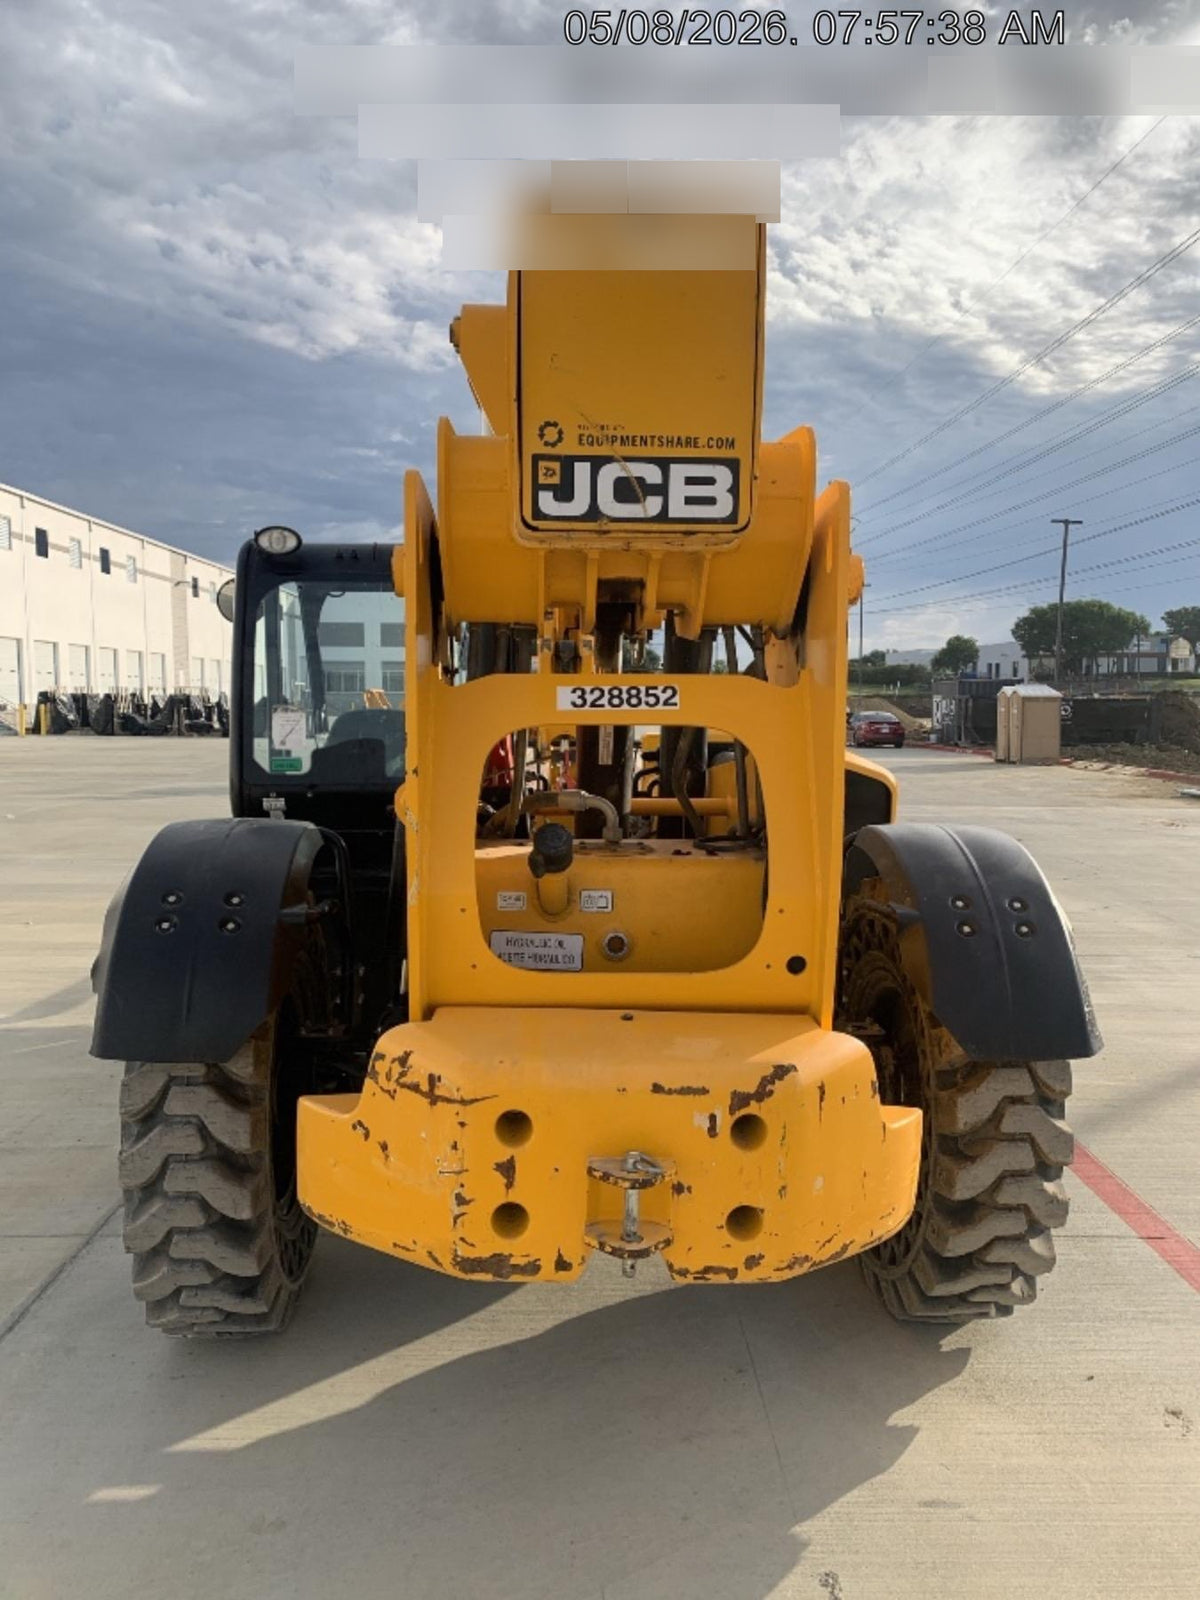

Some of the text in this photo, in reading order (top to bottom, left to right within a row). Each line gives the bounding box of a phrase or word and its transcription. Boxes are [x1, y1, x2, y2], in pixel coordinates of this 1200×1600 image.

[577, 433, 736, 450] EQUIPMENTSHARE.COM
[538, 461, 734, 518] JCB
[570, 686, 678, 708] 328852
